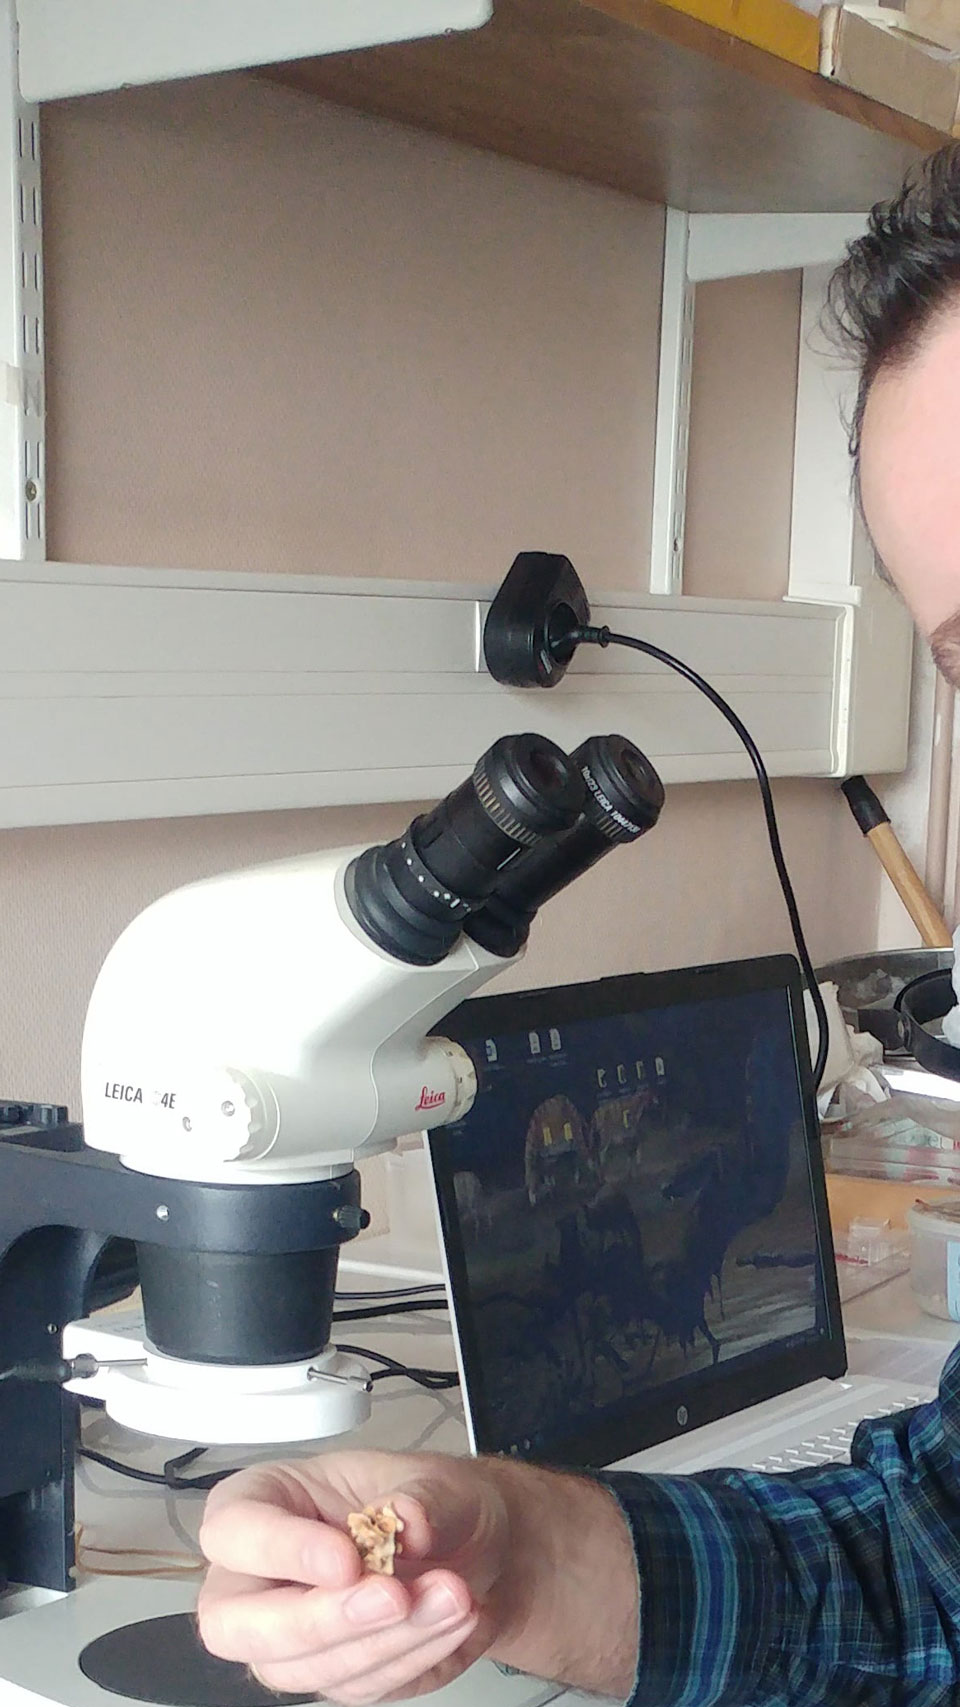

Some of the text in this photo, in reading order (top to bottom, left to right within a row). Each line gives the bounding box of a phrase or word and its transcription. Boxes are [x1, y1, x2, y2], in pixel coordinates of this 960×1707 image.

[594, 790, 613, 812] LEICA
[105, 1081, 177, 1109] LEICA 4E
[415, 1085, 446, 1111] Leica
